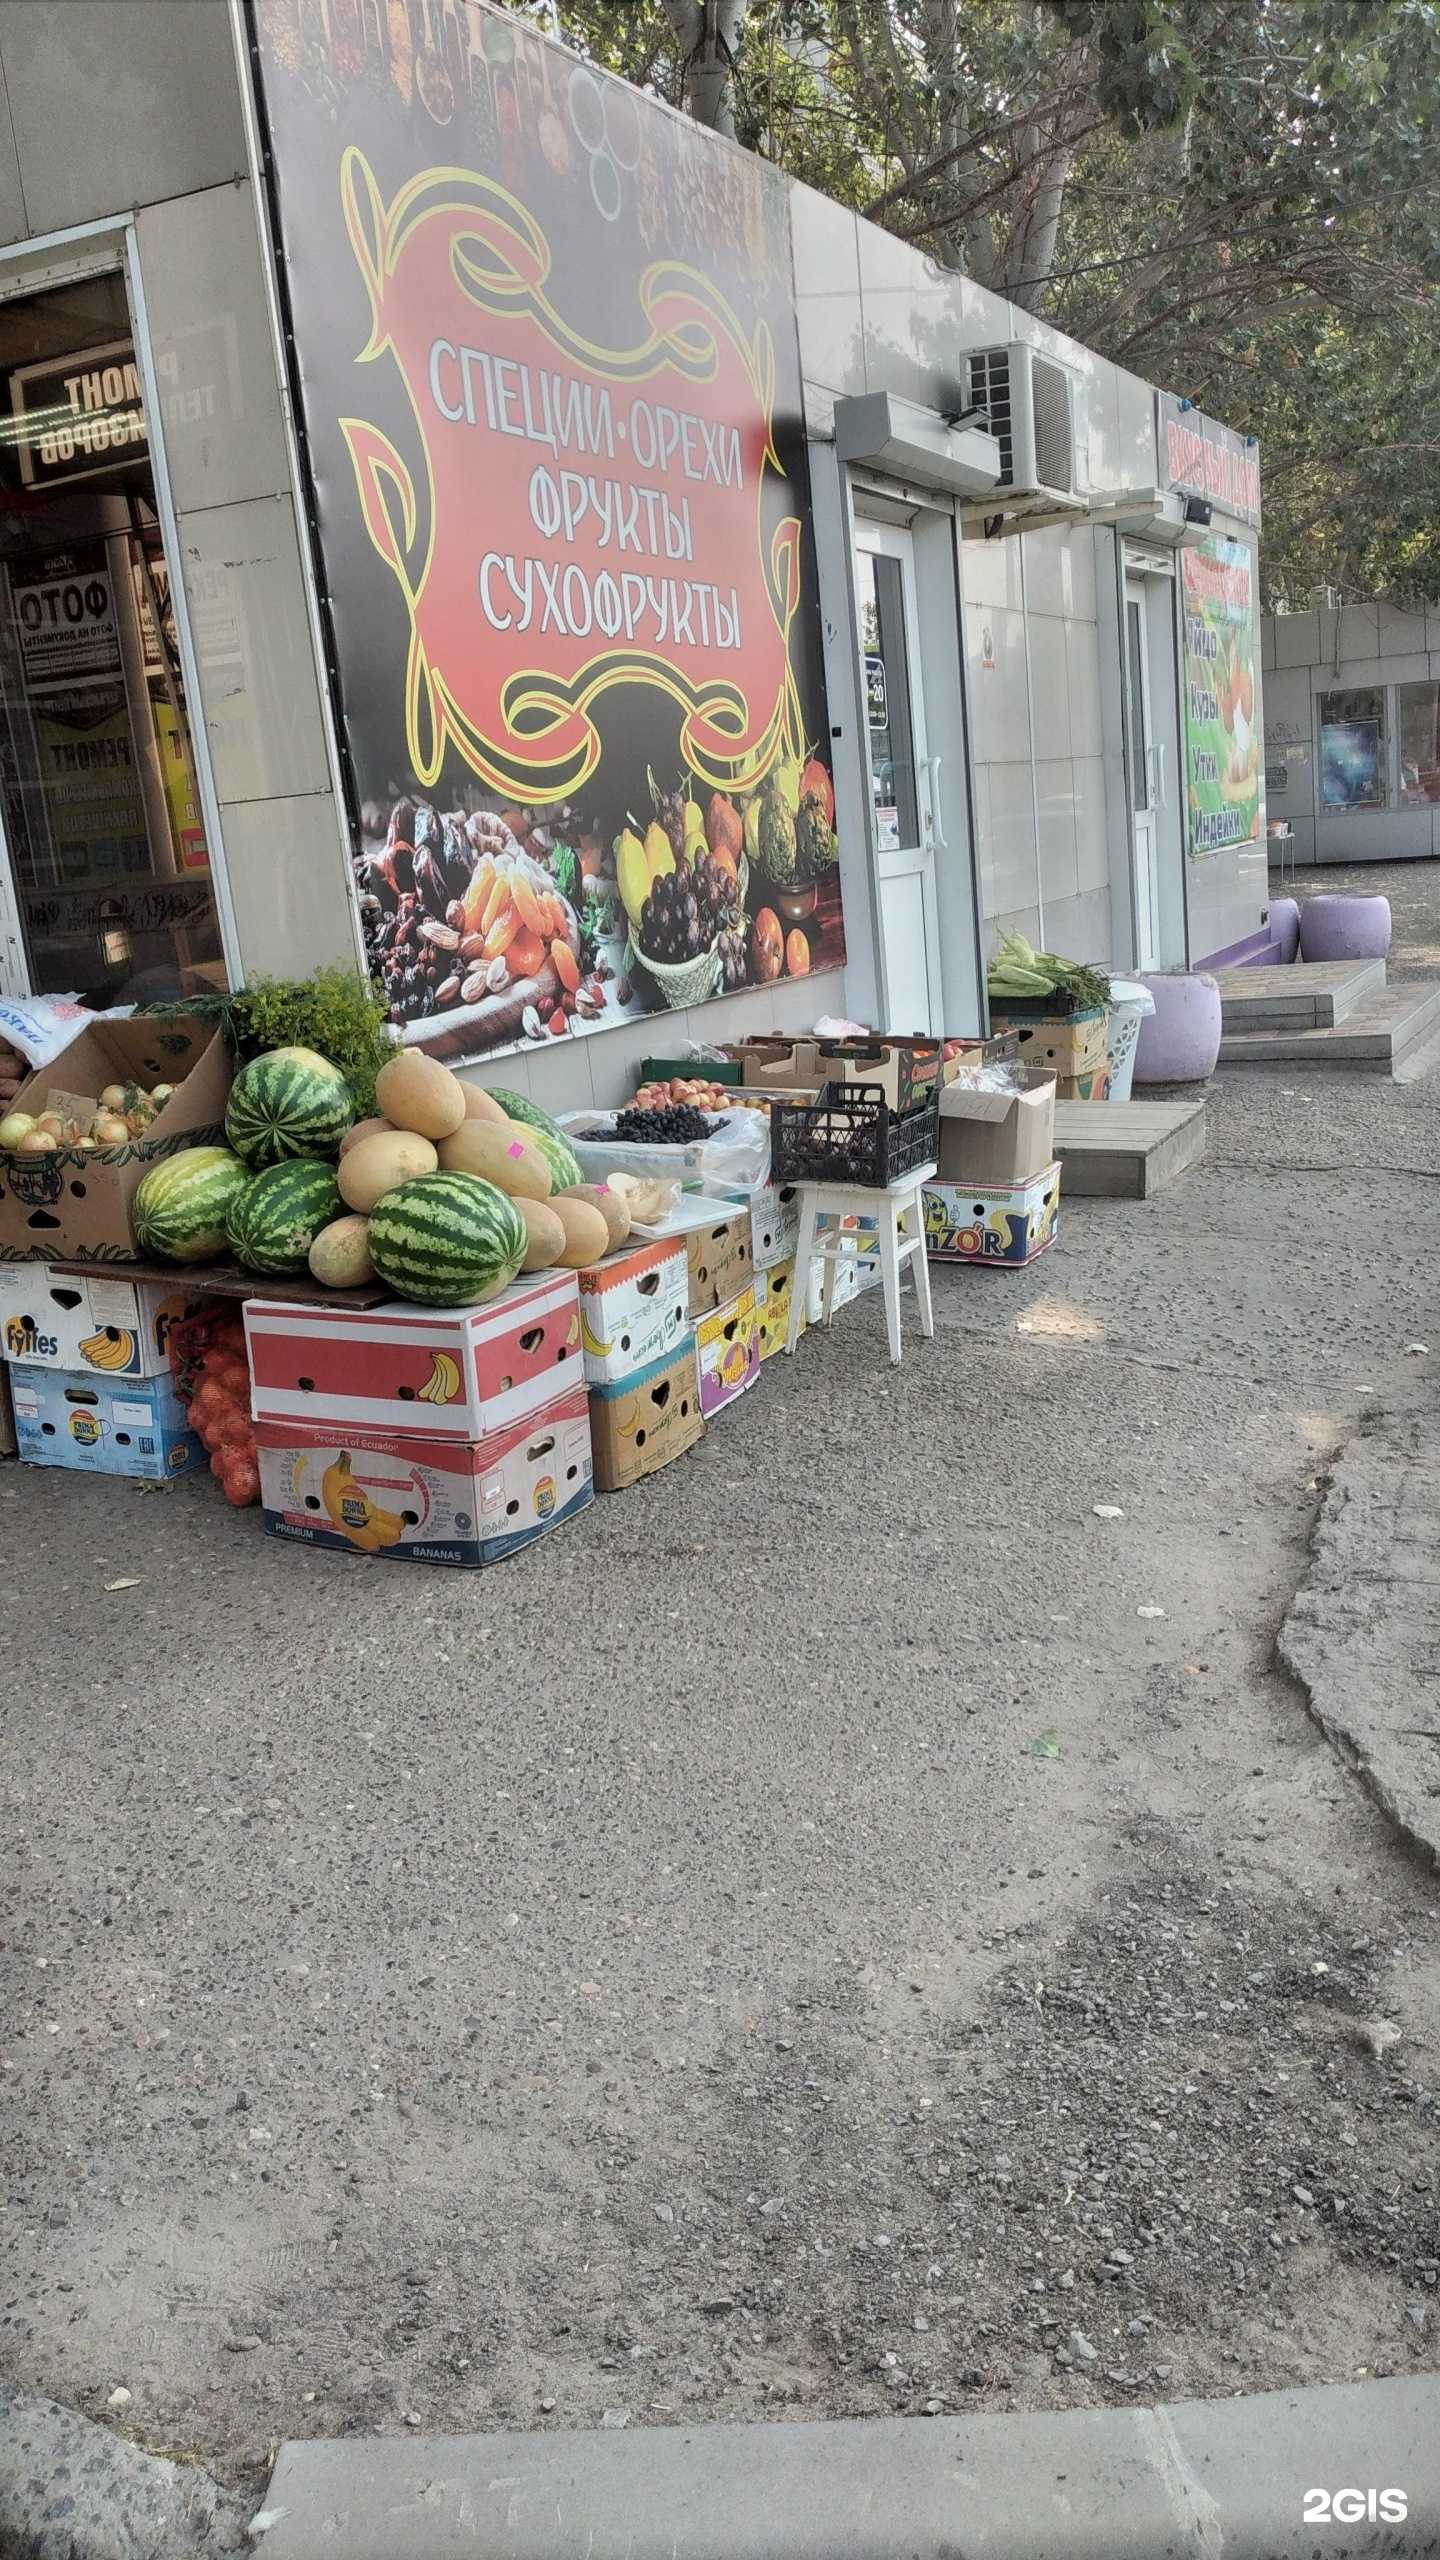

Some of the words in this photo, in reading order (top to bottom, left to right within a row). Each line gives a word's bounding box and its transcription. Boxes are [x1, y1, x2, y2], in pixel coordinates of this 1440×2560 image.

[630, 399, 744, 490] ОРЕХИ
[529, 465, 693, 561] ФРУКТЫ
[479, 551, 742, 649] СУХОФРУКТЫ
[313, 1433, 348, 1446] Product
[350, 1438, 360, 1447] of
[275, 1523, 314, 1539] PREMIUM
[412, 1546, 462, 1561] BANANAS
